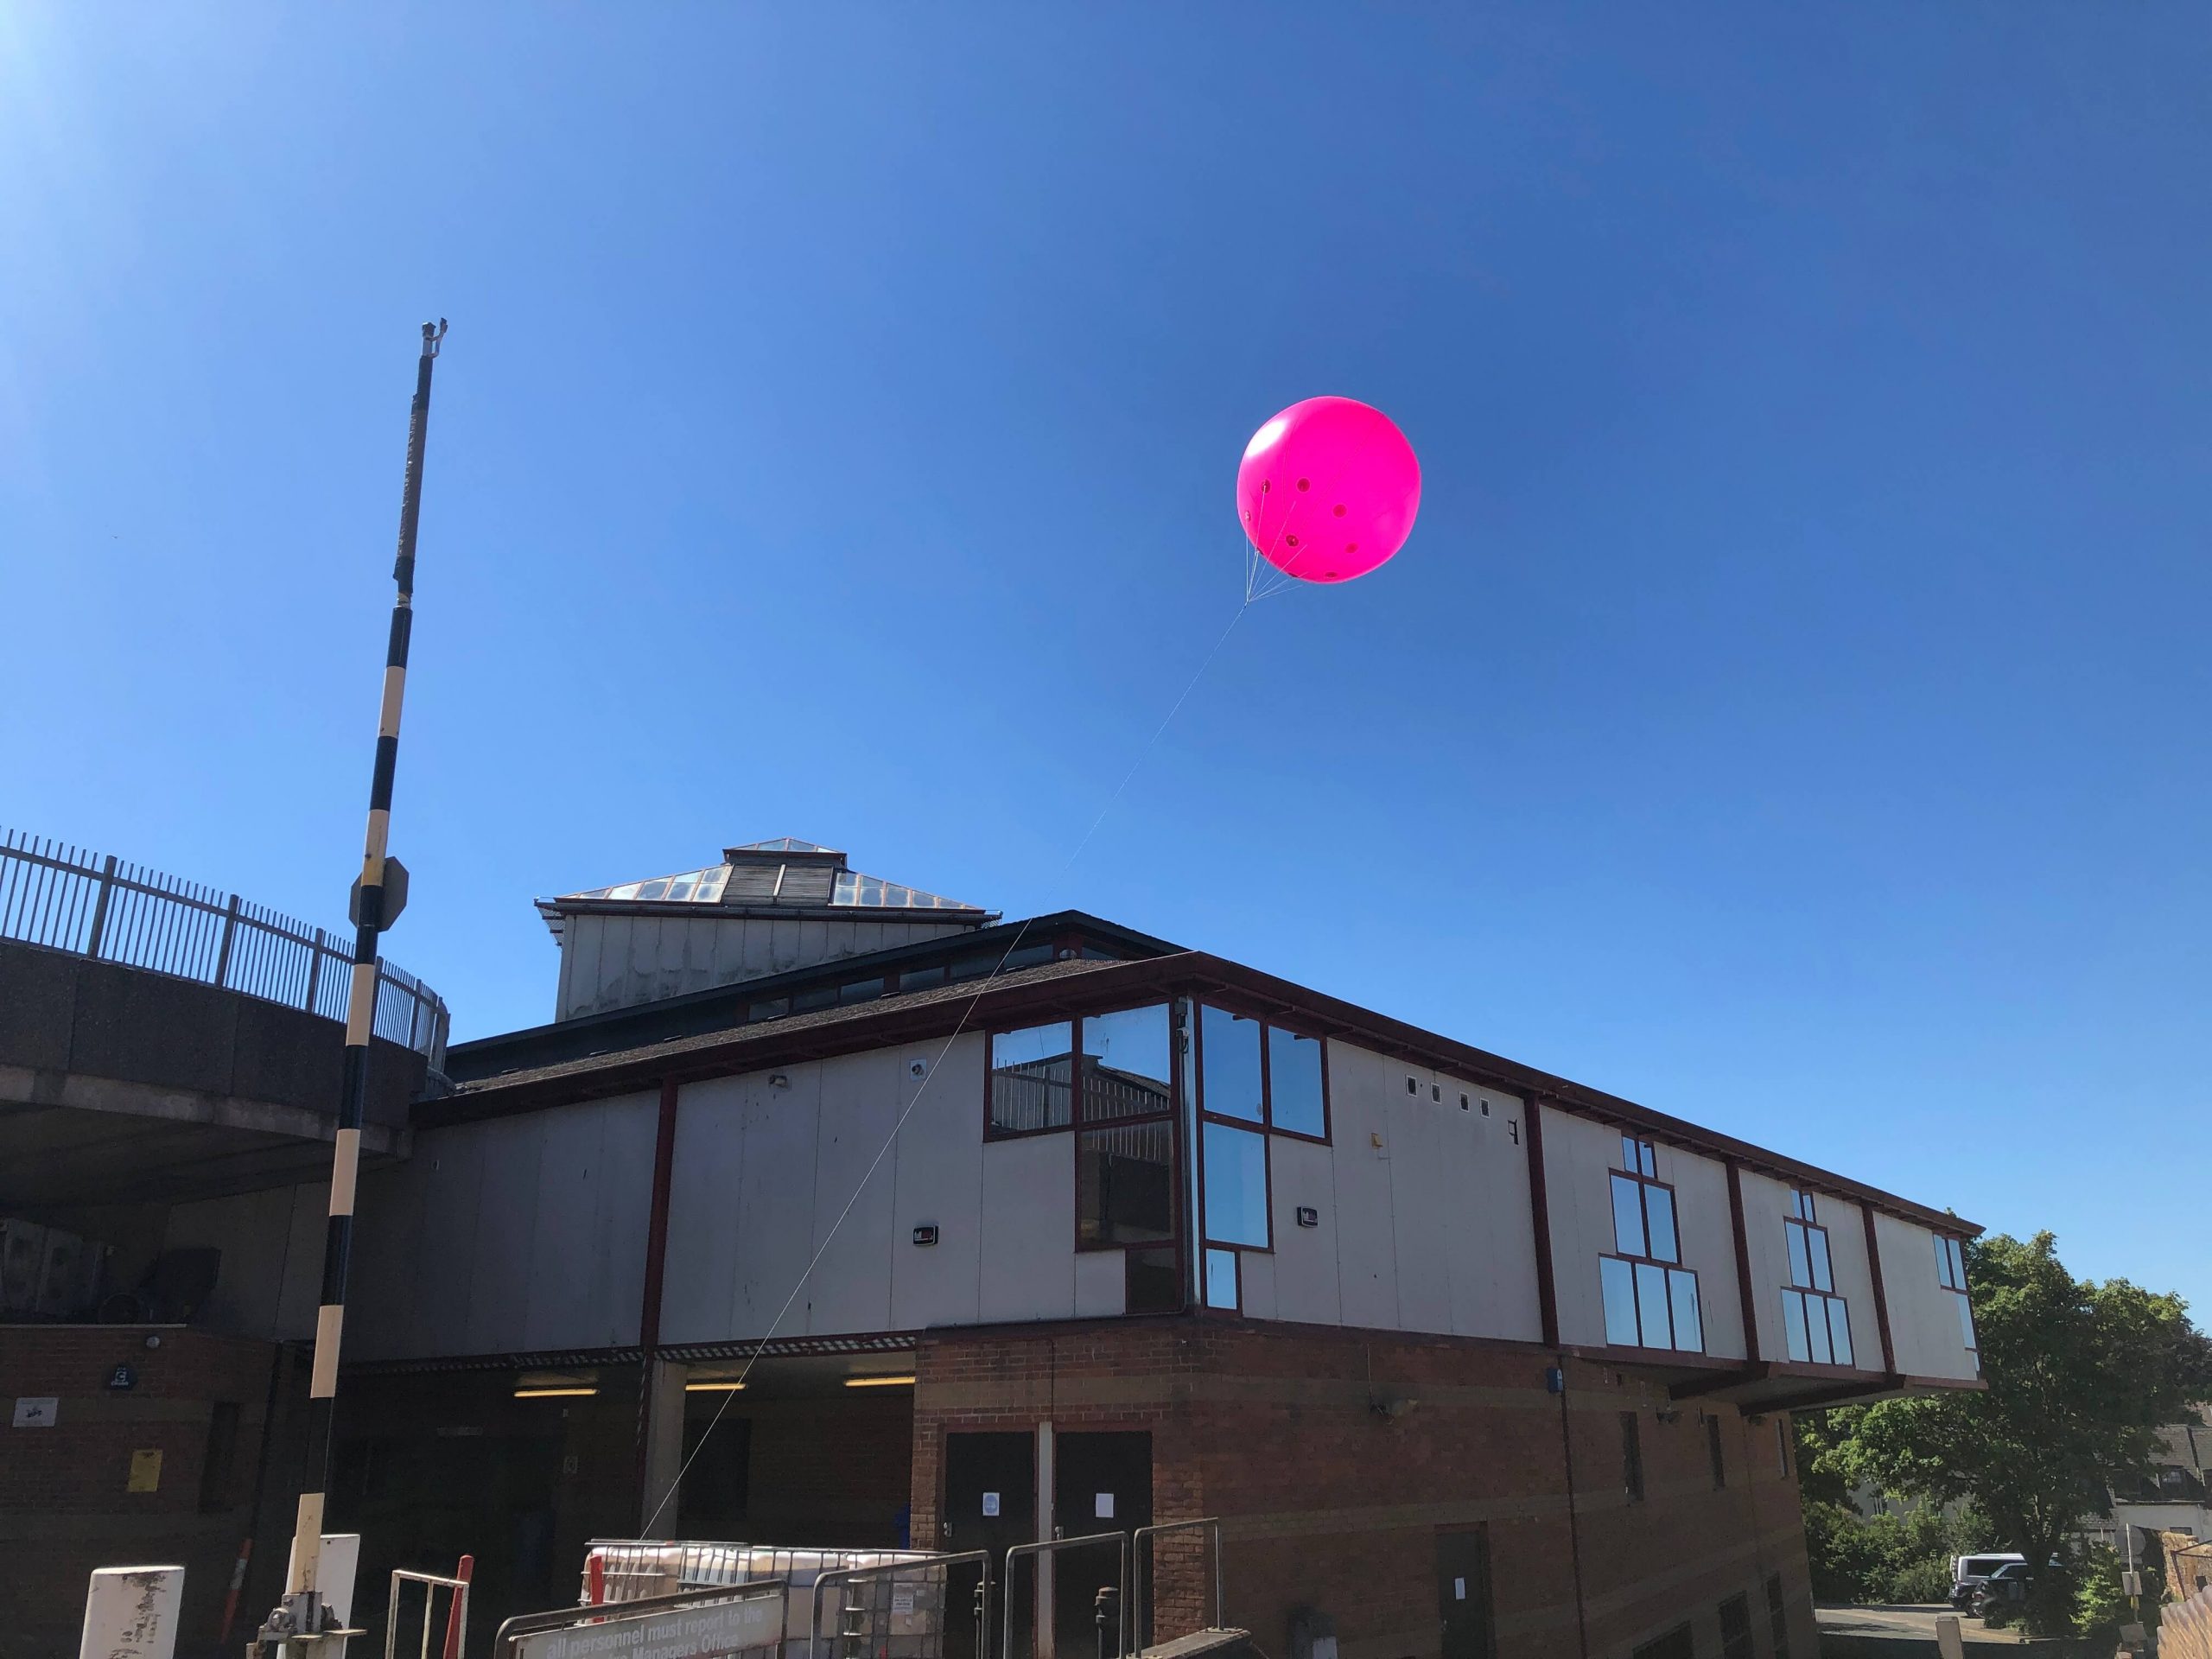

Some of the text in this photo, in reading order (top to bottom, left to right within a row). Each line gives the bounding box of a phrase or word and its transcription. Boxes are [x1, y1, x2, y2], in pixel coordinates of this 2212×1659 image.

[546, 1606, 762, 1659] all personnel must report to the
[632, 1631, 739, 1659] Managers Office
